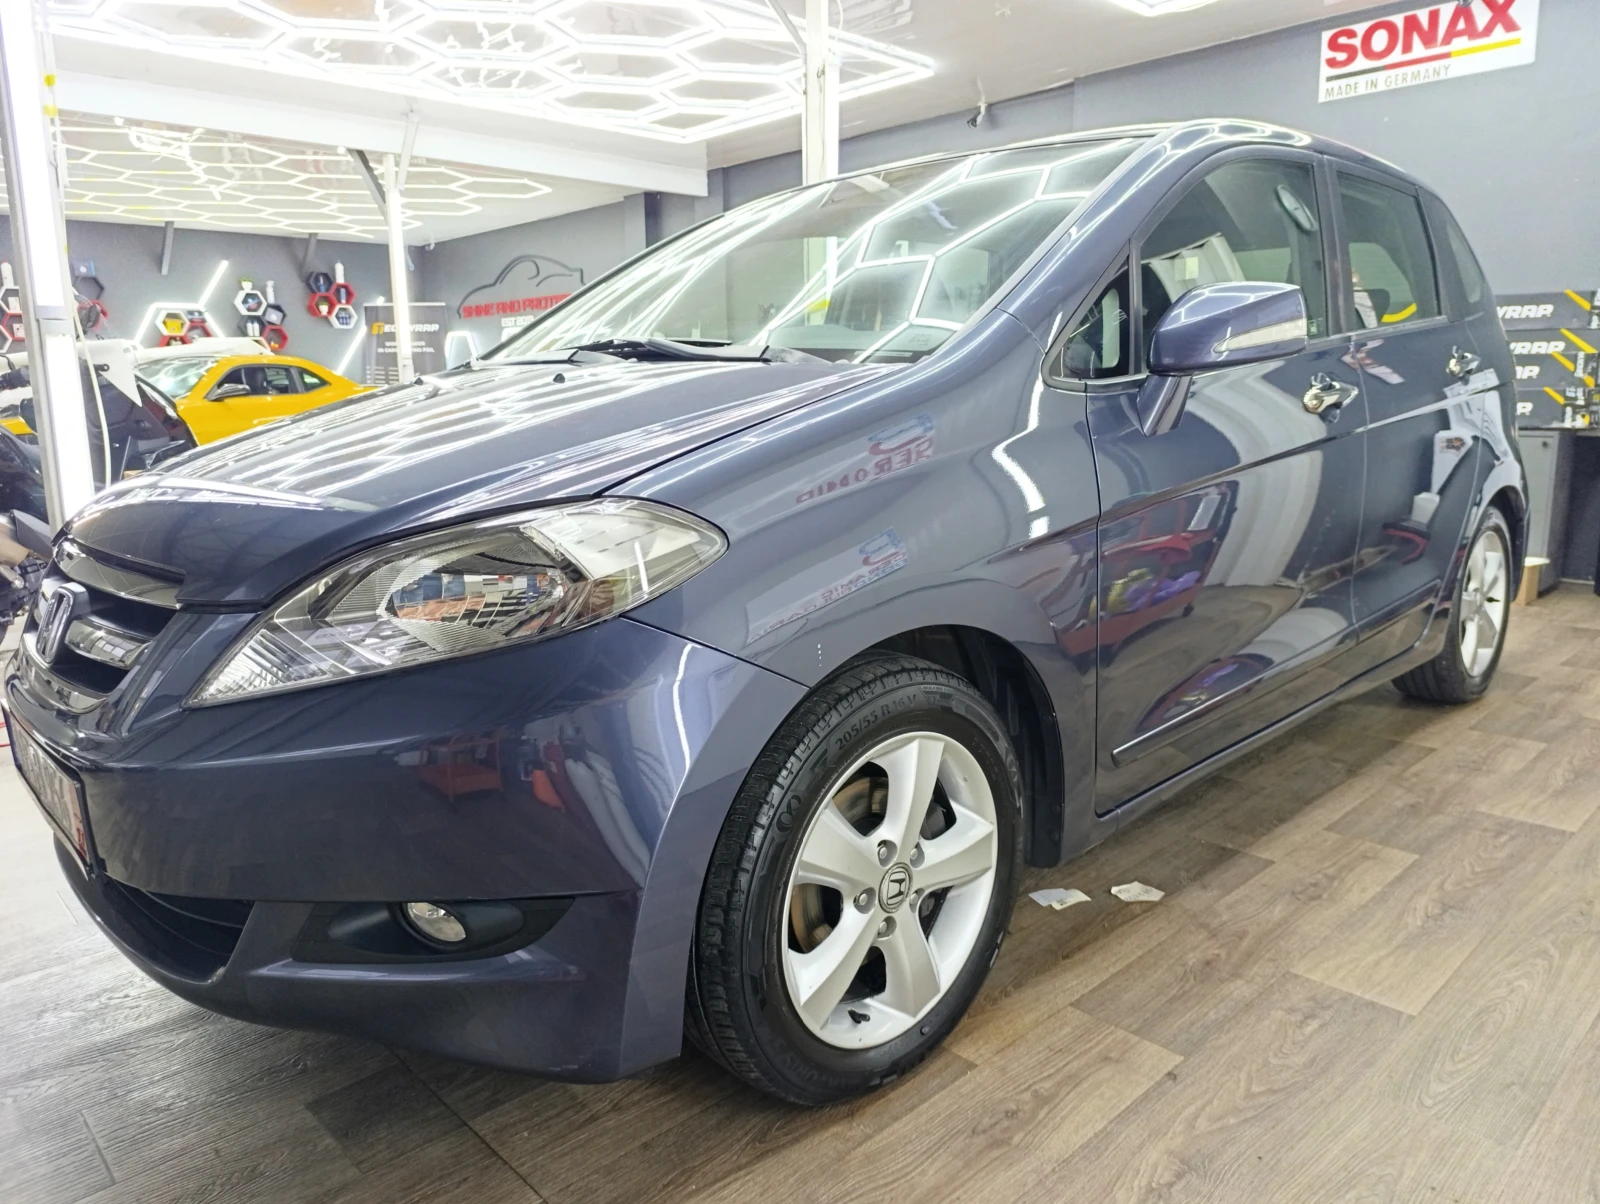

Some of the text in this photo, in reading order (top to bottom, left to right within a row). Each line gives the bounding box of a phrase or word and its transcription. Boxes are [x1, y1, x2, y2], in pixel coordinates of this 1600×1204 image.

[1325, 0, 1522, 70] SONAX
[1324, 64, 1452, 100] MADE IN GERMANY
[462, 302, 495, 319] SHINE
[496, 299, 521, 315] AND
[835, 710, 879, 752] 205/55
